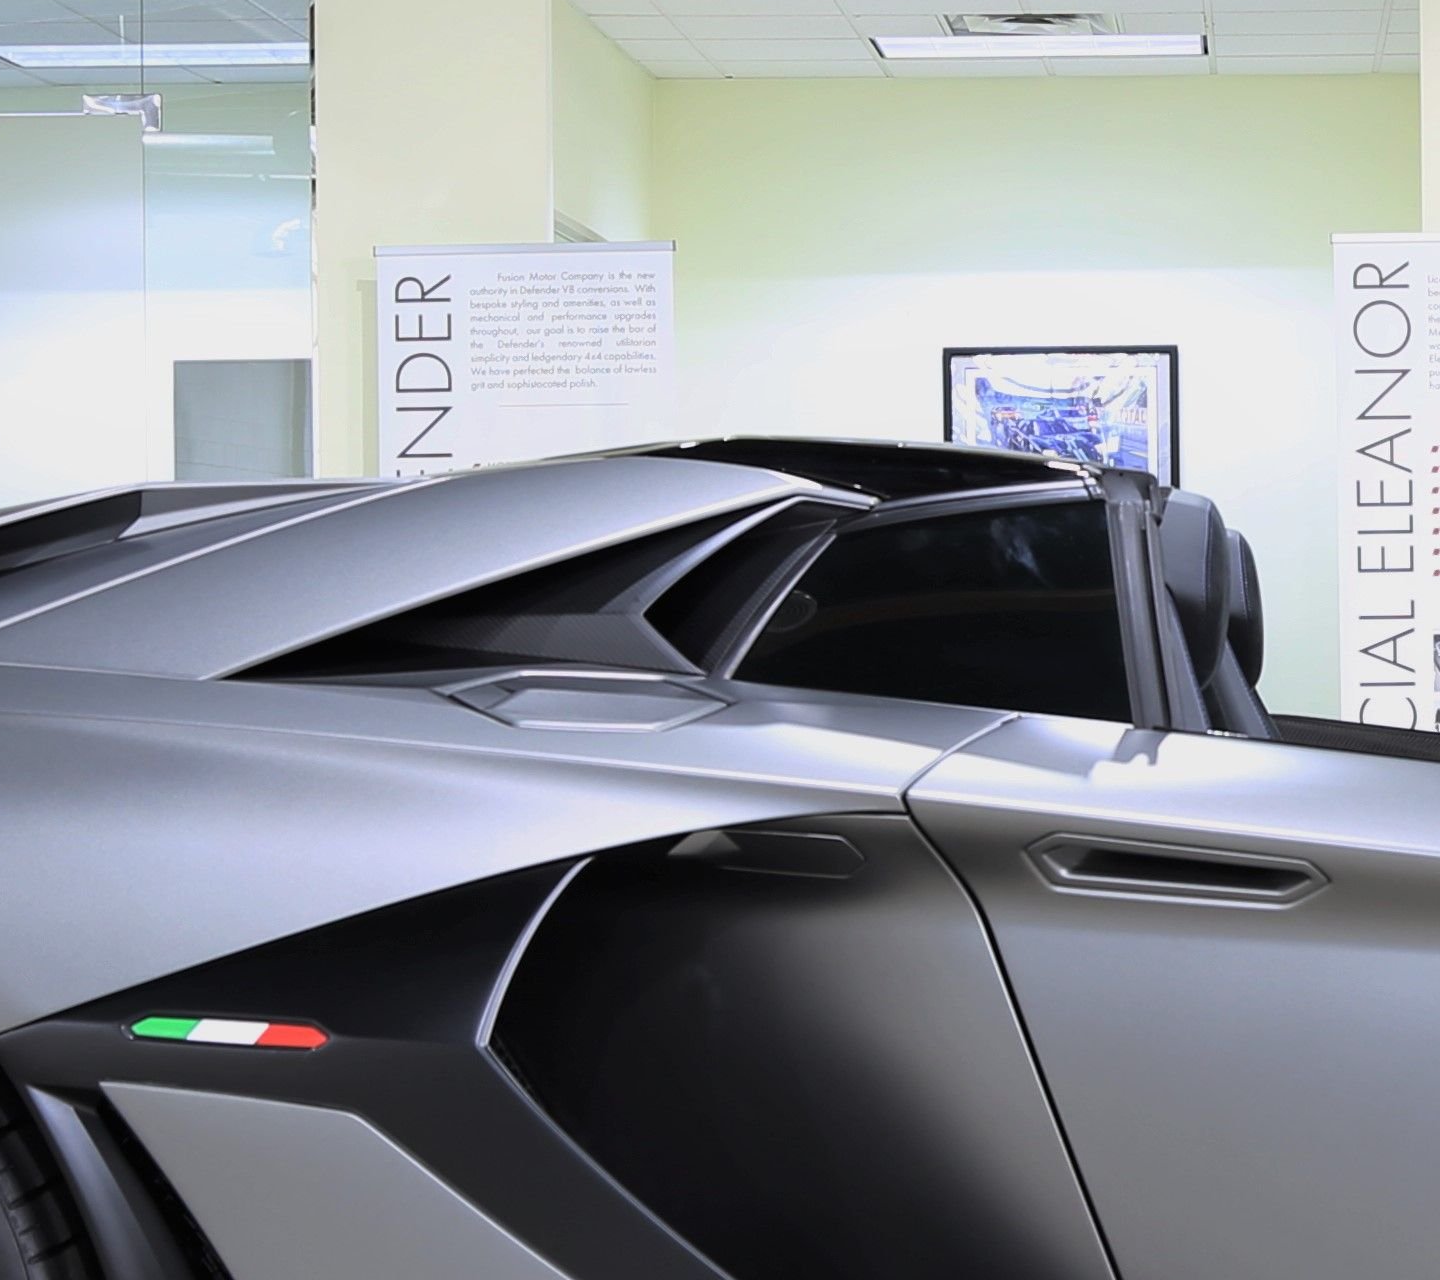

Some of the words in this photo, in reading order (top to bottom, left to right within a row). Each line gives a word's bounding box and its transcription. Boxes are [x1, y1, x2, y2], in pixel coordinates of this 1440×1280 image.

[497, 272, 525, 281] Fusion
[528, 272, 556, 281] Motor
[560, 271, 604, 283] Company
[619, 270, 632, 280] the
[469, 286, 508, 299] authority
[520, 285, 560, 295] Defender
[634, 284, 656, 293] With
[469, 299, 507, 311] bespoke
[511, 299, 538, 311] styling
[542, 298, 559, 308] and
[623, 297, 642, 306] well
[470, 312, 520, 322] mechanical
[527, 312, 544, 321] and
[551, 311, 607, 323] performance
[614, 310, 656, 323] upgrades
[1428, 314, 1440, 323] the
[544, 325, 564, 337] goal
[588, 324, 609, 333] raise
[612, 324, 625, 333] the
[629, 324, 643, 333] bar
[470, 339, 483, 348] the
[497, 339, 545, 348] Defender's
[558, 338, 602, 348] renowned
[616, 337, 656, 347] utilitarian
[471, 353, 510, 365] simplicity
[512, 352, 529, 362] and
[394, 273, 453, 477] NDER
[471, 366, 487, 375] We
[489, 366, 510, 375] have
[512, 365, 554, 378] perfected
[557, 365, 570, 375] the
[575, 365, 611, 374] balance
[624, 364, 656, 374] lawless
[471, 380, 485, 392] grit
[487, 379, 505, 389] and
[1352, 260, 1415, 574] ELEANOR
